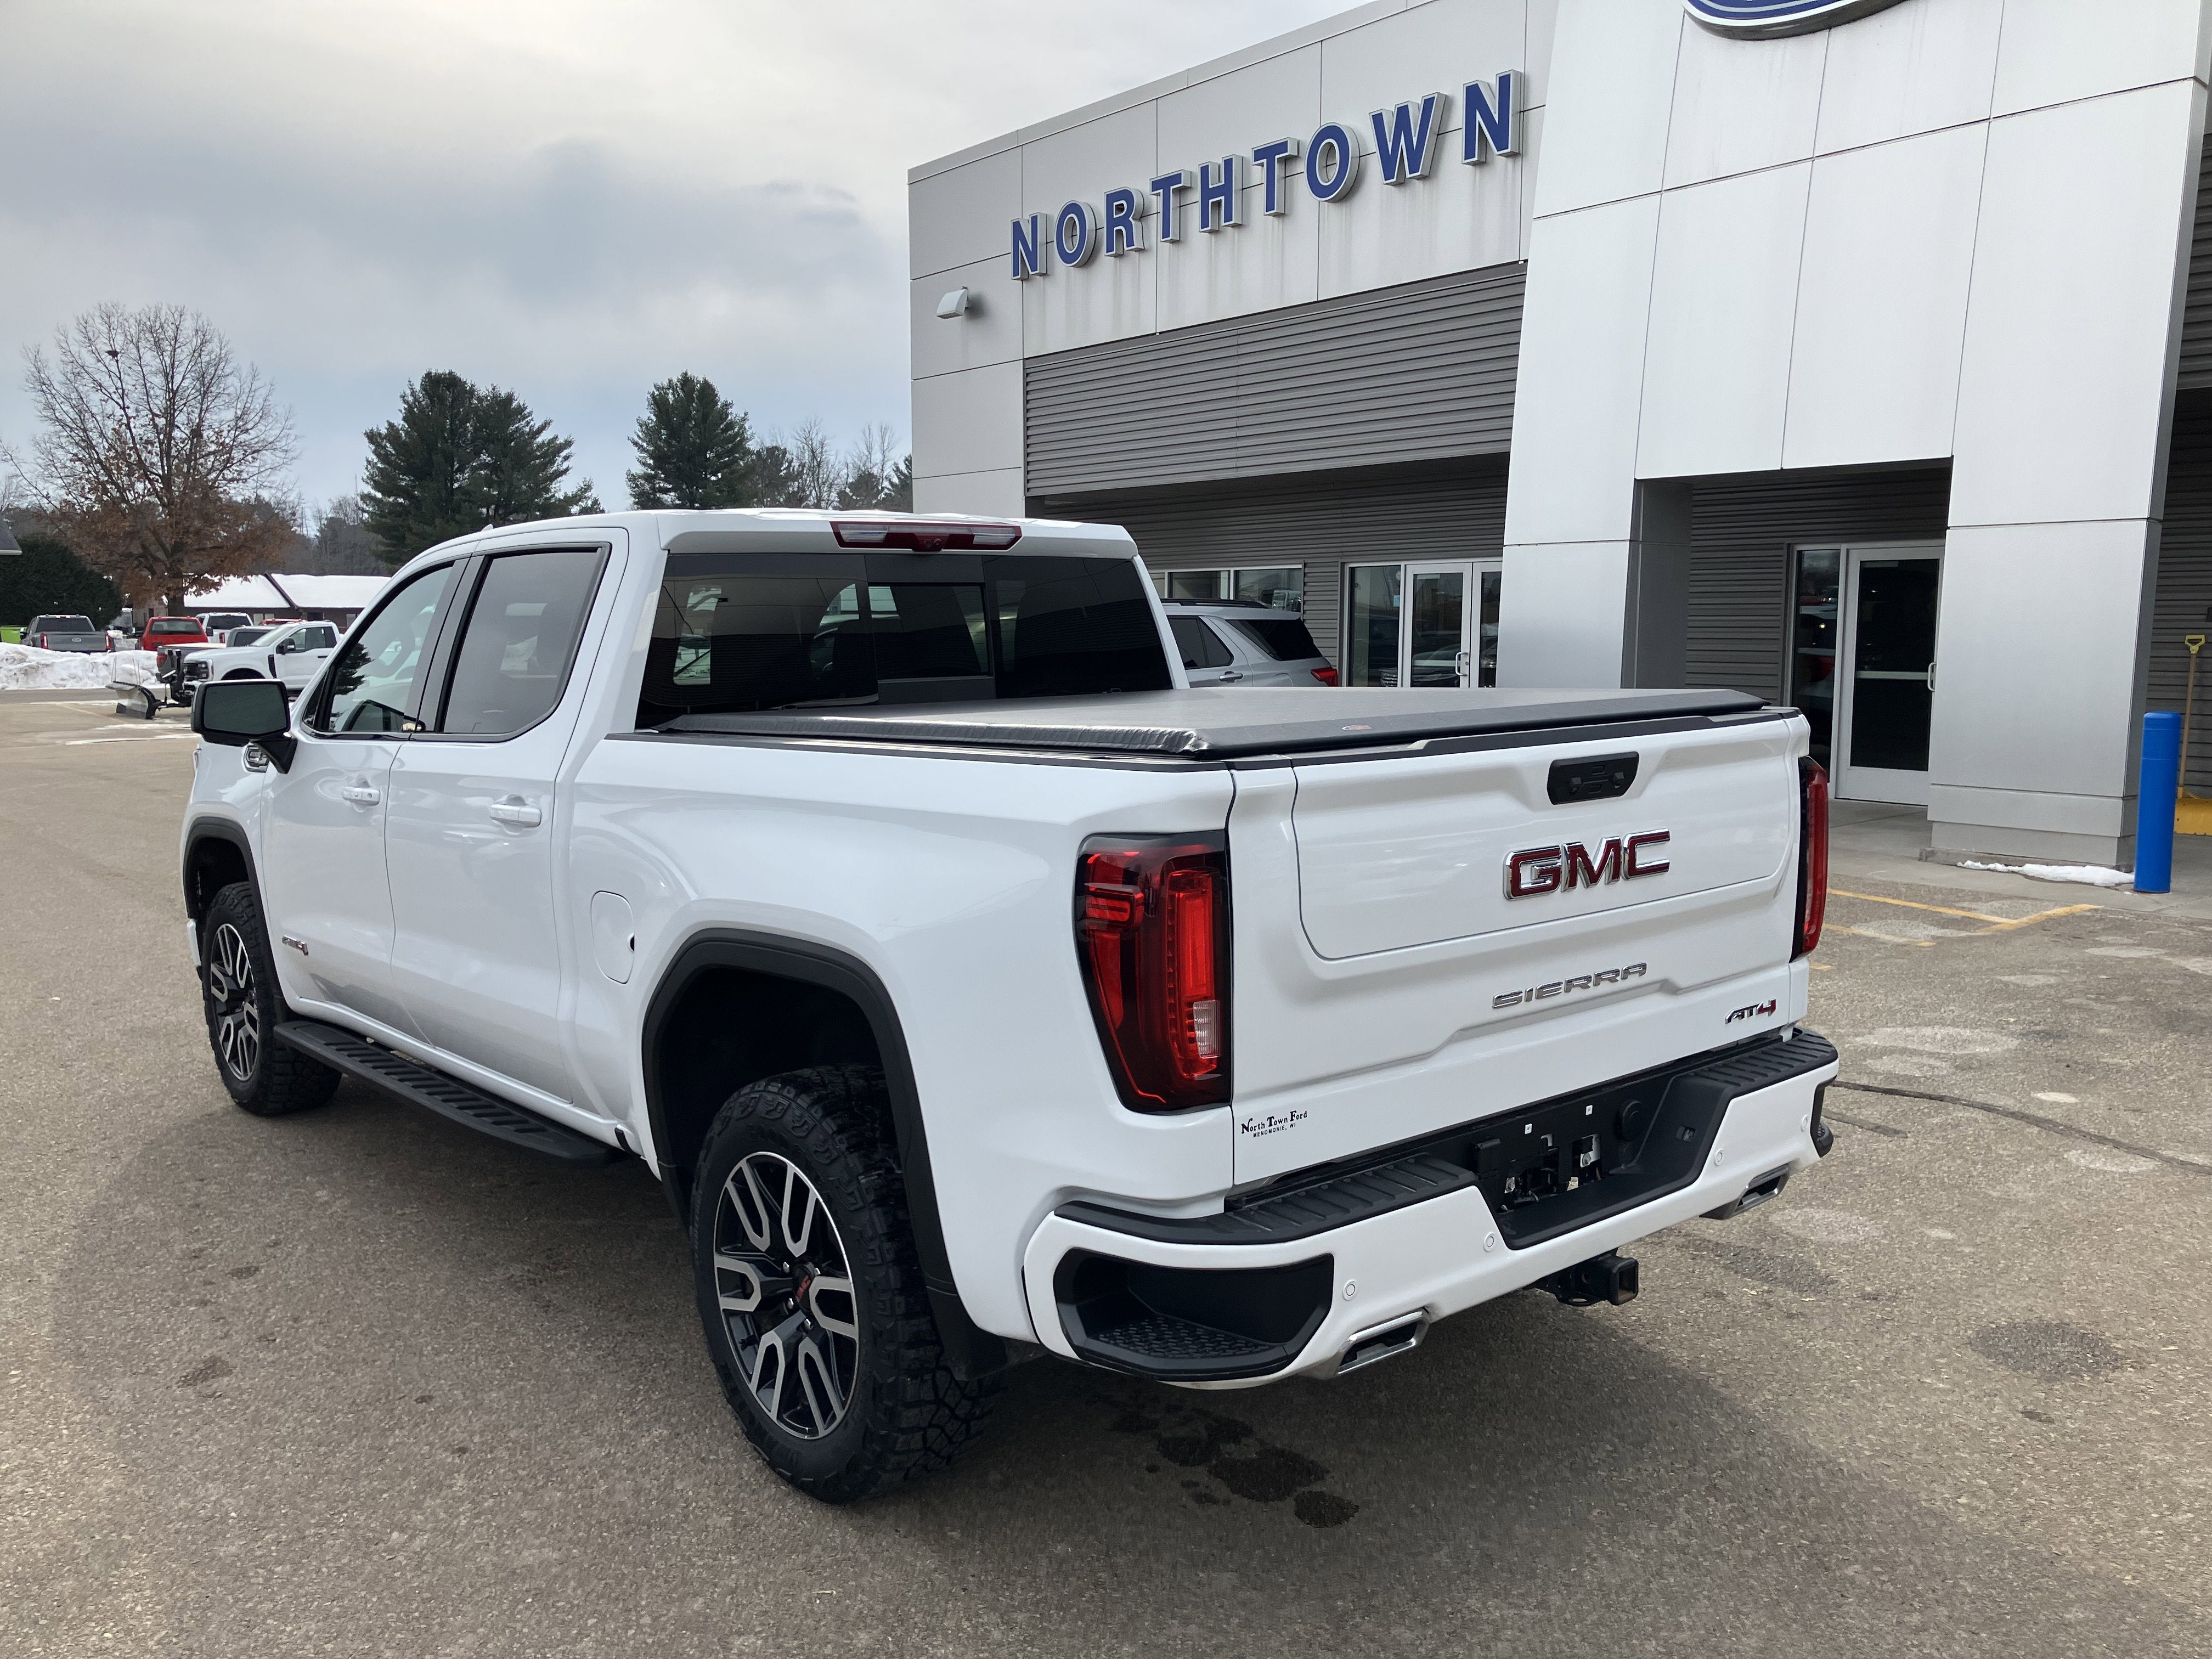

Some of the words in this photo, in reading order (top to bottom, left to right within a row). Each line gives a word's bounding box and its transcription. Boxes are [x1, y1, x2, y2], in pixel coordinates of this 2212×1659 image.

[1011, 69, 1522, 281] NORTHTOWN
[1503, 828, 1670, 901] GMC
[1492, 962, 1647, 1009] SIERRA
[1724, 998, 1776, 1025] AT4
[1241, 1118, 1265, 1134] North
[1266, 1116, 1288, 1127] Town
[1290, 1110, 1307, 1121] Ford
